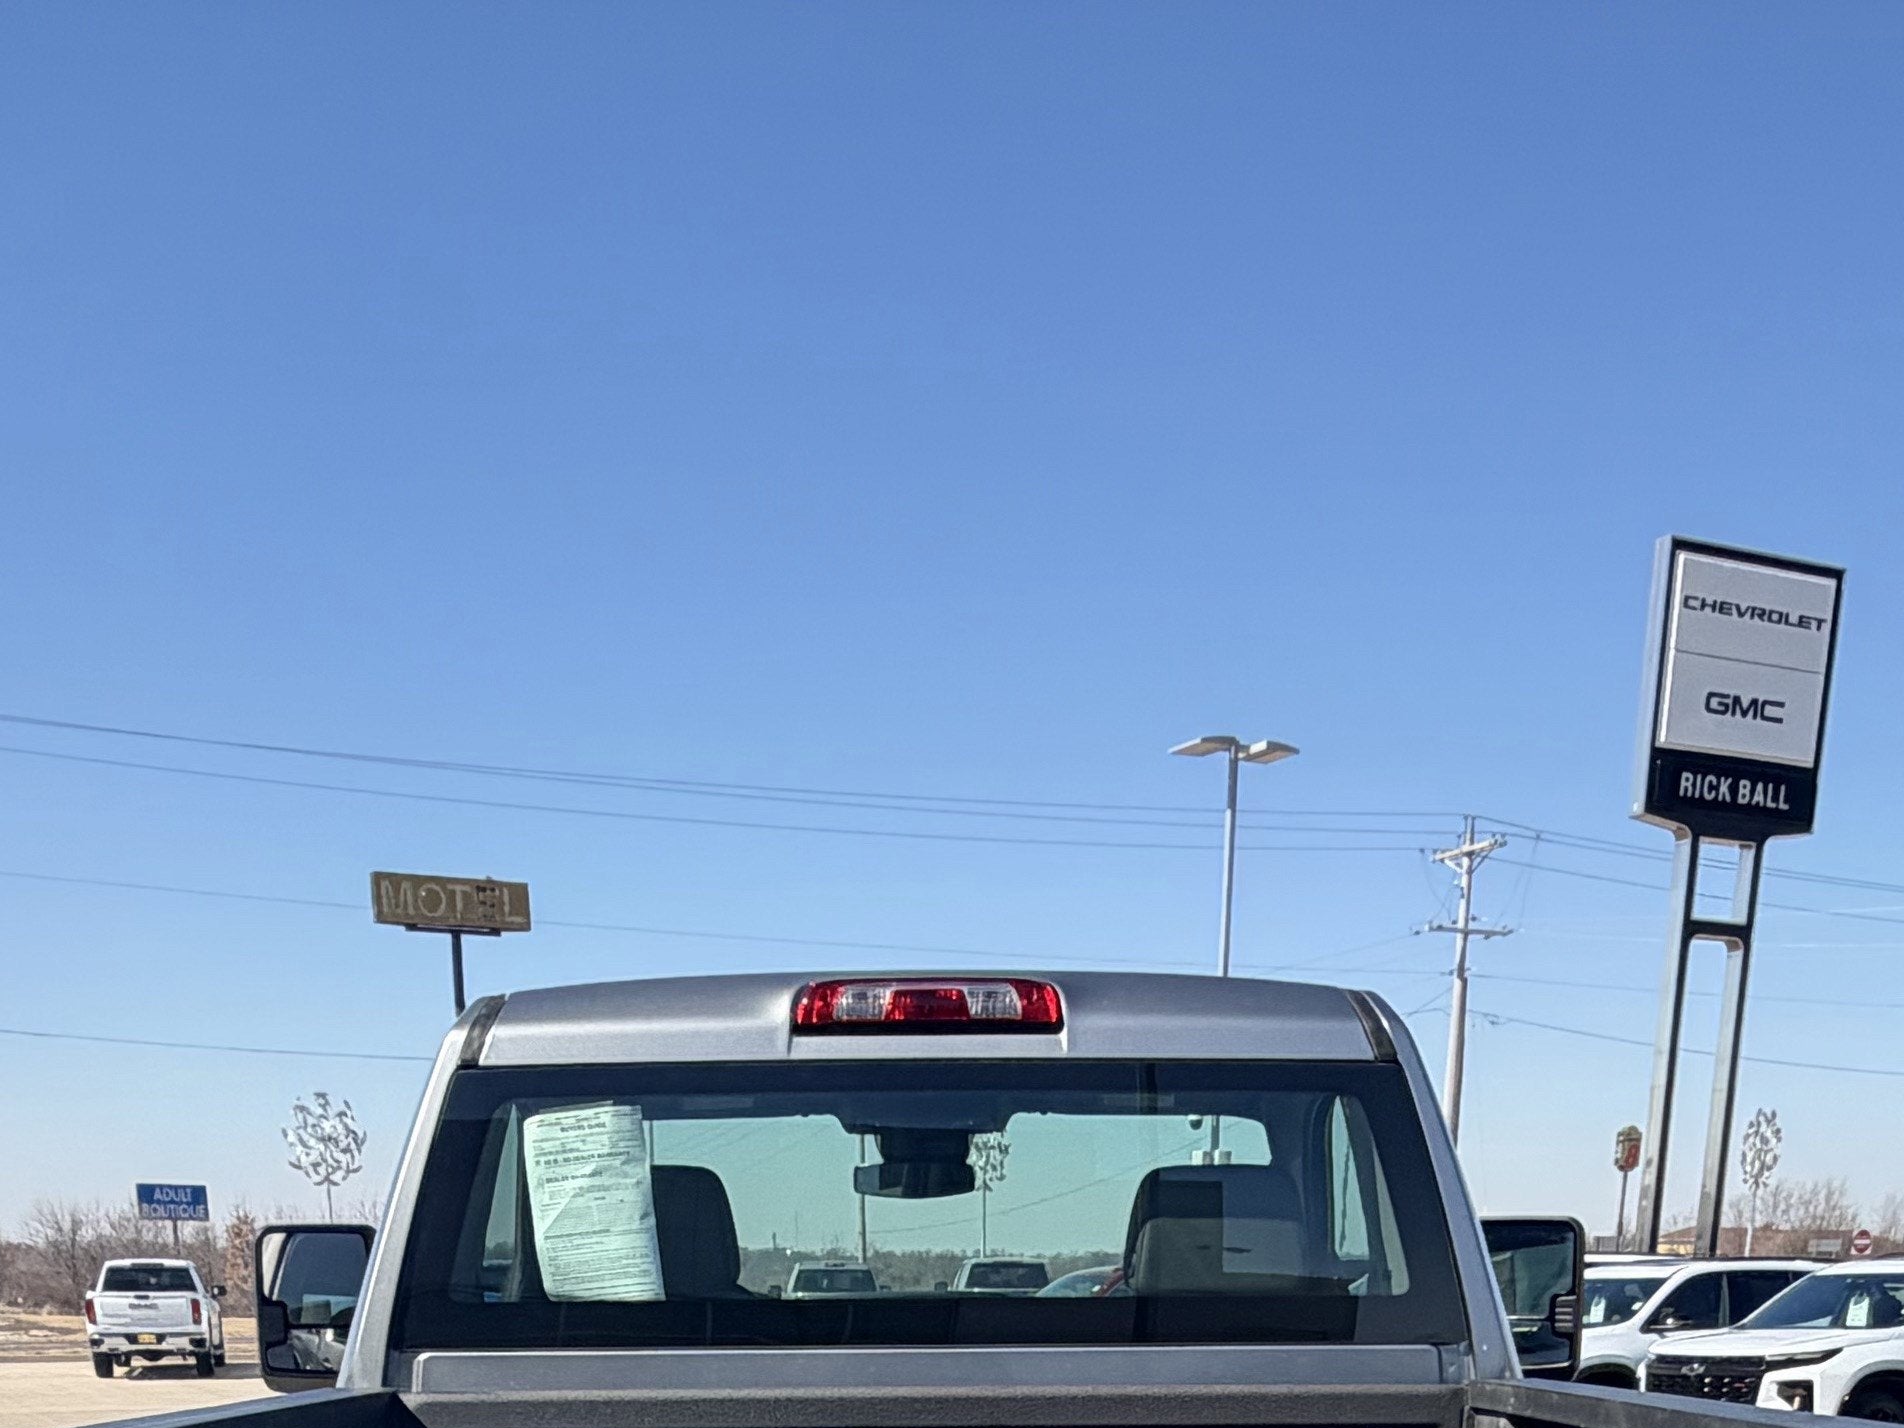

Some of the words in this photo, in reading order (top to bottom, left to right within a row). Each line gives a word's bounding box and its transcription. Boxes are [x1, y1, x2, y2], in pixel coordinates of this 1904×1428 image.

[1682, 594, 1828, 632] CHEVROLET
[1704, 691, 1786, 724] GMC
[1679, 771, 1733, 803] RICK
[1737, 779, 1790, 810] BALL
[141, 1203, 206, 1218] BOUTIQUE
[153, 1187, 193, 1202] ADULT
